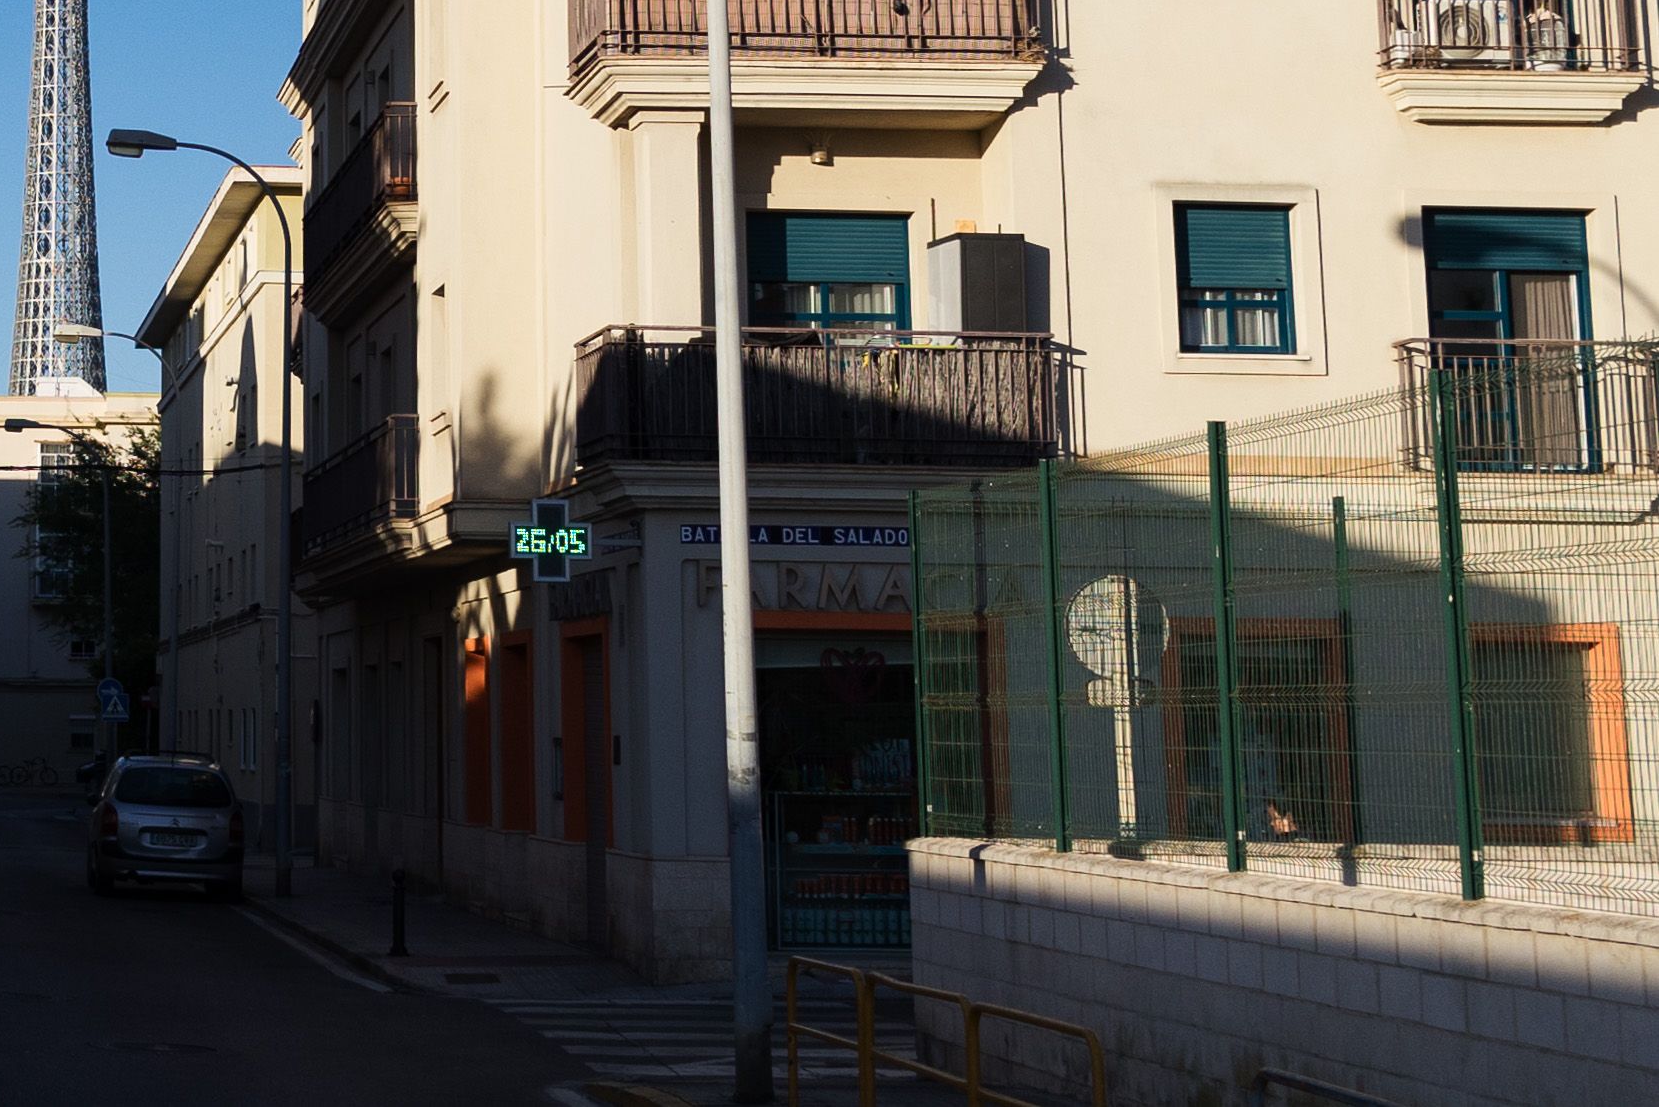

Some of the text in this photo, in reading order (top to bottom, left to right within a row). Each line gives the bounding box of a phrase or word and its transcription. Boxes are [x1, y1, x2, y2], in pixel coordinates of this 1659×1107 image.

[681, 526, 909, 545] BATA DEL SALADO
